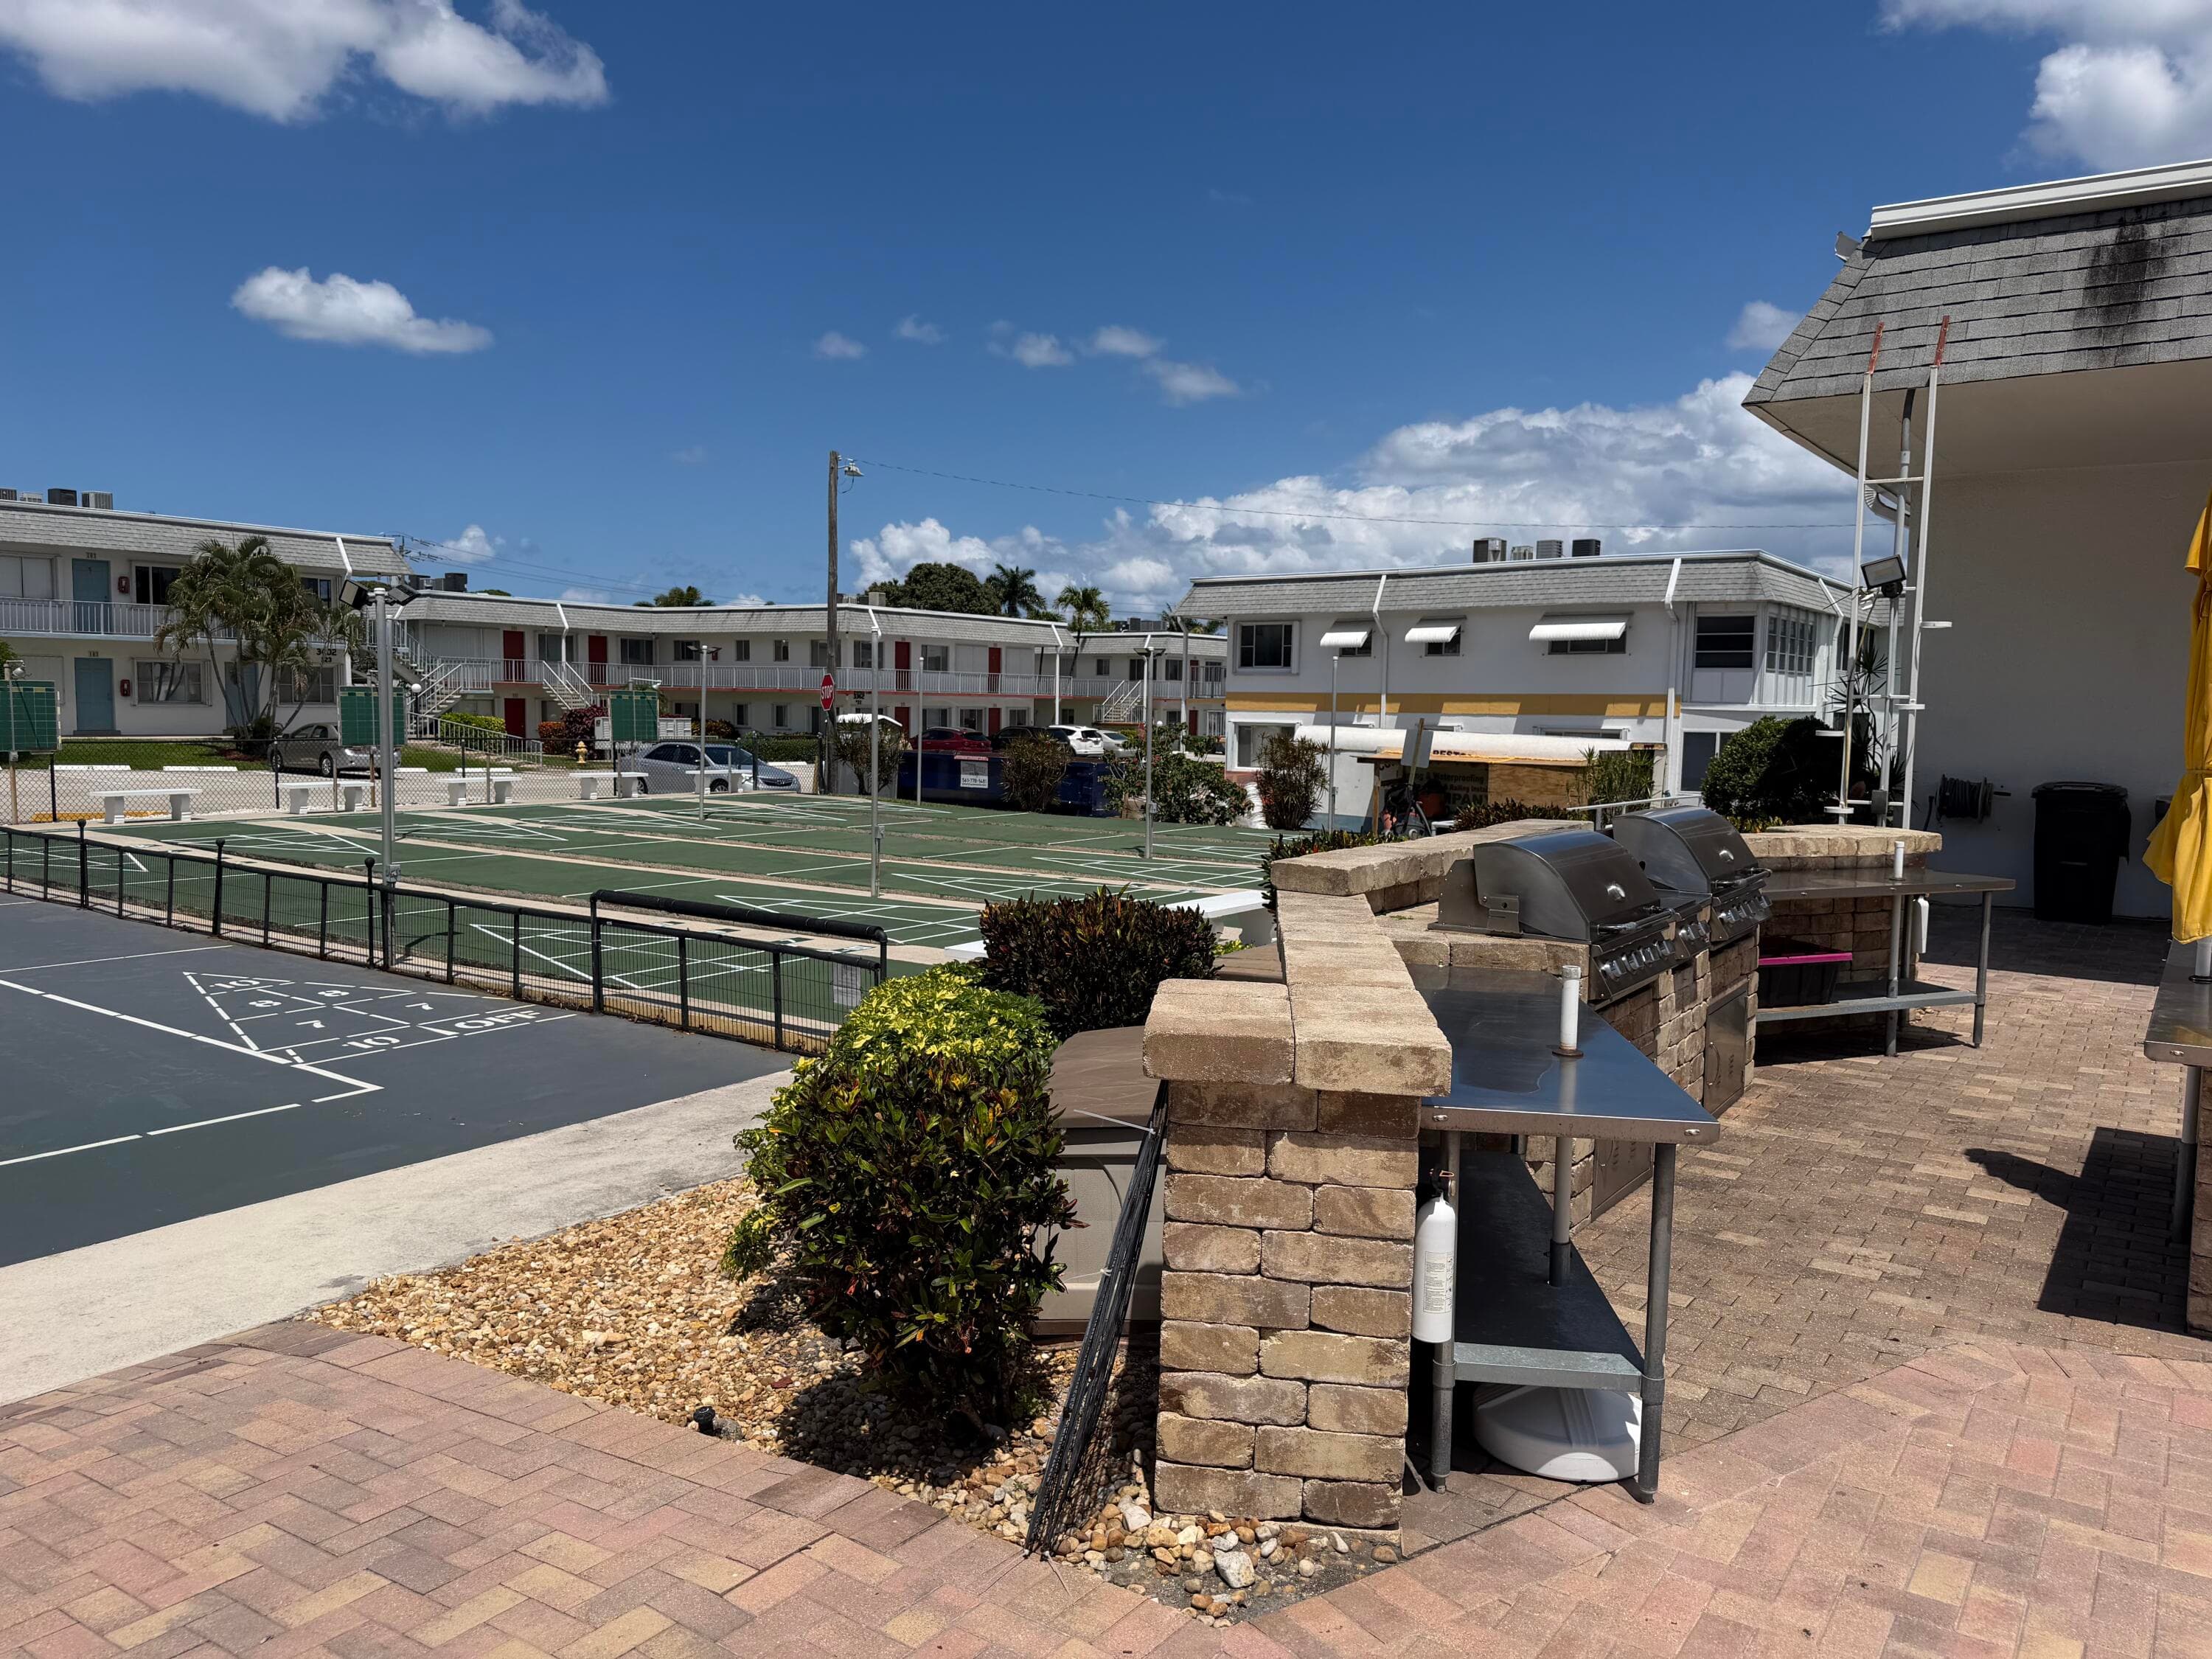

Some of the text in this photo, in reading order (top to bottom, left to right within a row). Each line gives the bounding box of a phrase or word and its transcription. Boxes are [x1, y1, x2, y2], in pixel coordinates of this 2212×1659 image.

[821, 685, 833, 700] STOP
[209, 979, 260, 989] 10
[317, 990, 350, 998] 8
[248, 1000, 282, 1008] 8
[405, 1002, 434, 1010] 7
[295, 1020, 325, 1029] 7
[341, 1010, 541, 1049] 10 OFF
